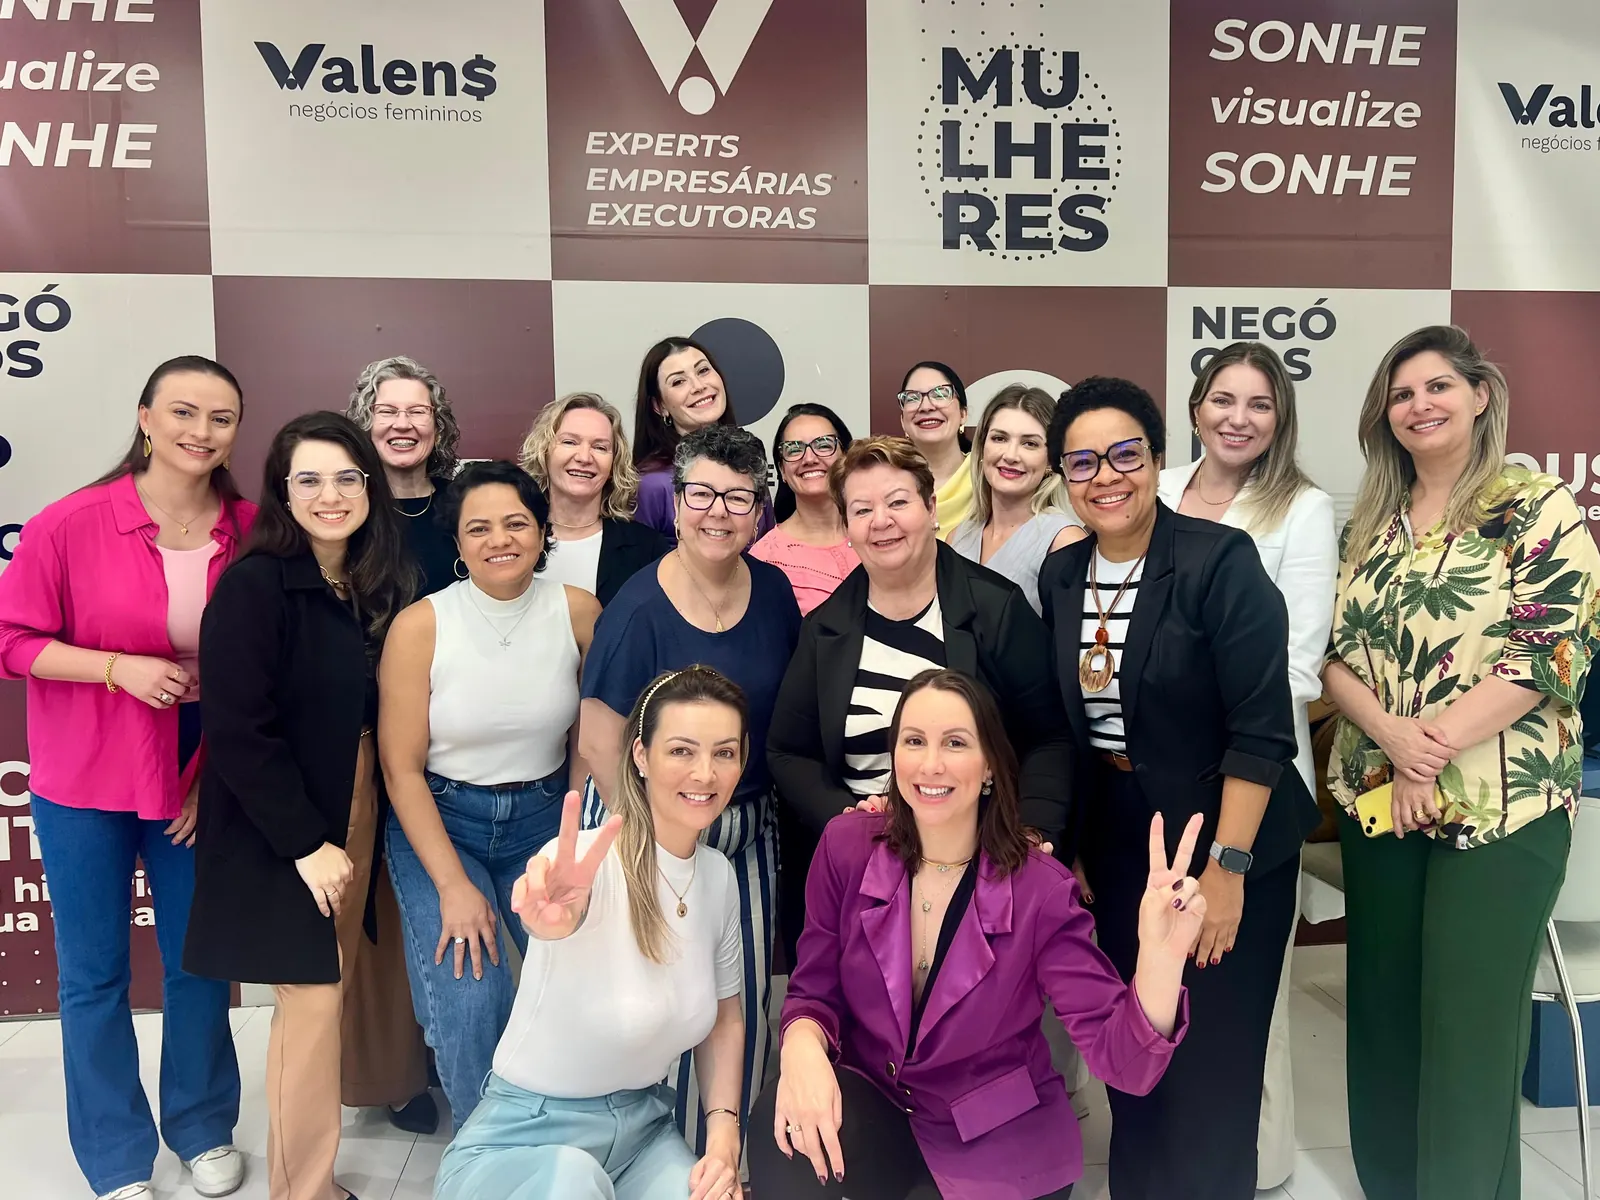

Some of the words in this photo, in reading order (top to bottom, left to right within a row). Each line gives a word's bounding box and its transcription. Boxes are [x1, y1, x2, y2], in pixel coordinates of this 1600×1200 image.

[1209, 19, 1426, 65] SONHE
[942, 47, 1079, 109] MU
[289, 101, 378, 122] negócios
[385, 102, 482, 122] femininos
[1211, 87, 1421, 128] visualize
[1498, 82, 1600, 128] Val
[586, 131, 740, 158] EXPERTS
[941, 120, 1110, 180] LHE
[1521, 134, 1592, 153] negócios
[586, 166, 832, 196] EMPRESÁRIAS
[1201, 151, 1416, 196] SONHE
[587, 202, 817, 230] EXECUTORAS
[942, 192, 1109, 252] RES
[1192, 297, 1337, 341] NEGÓ
